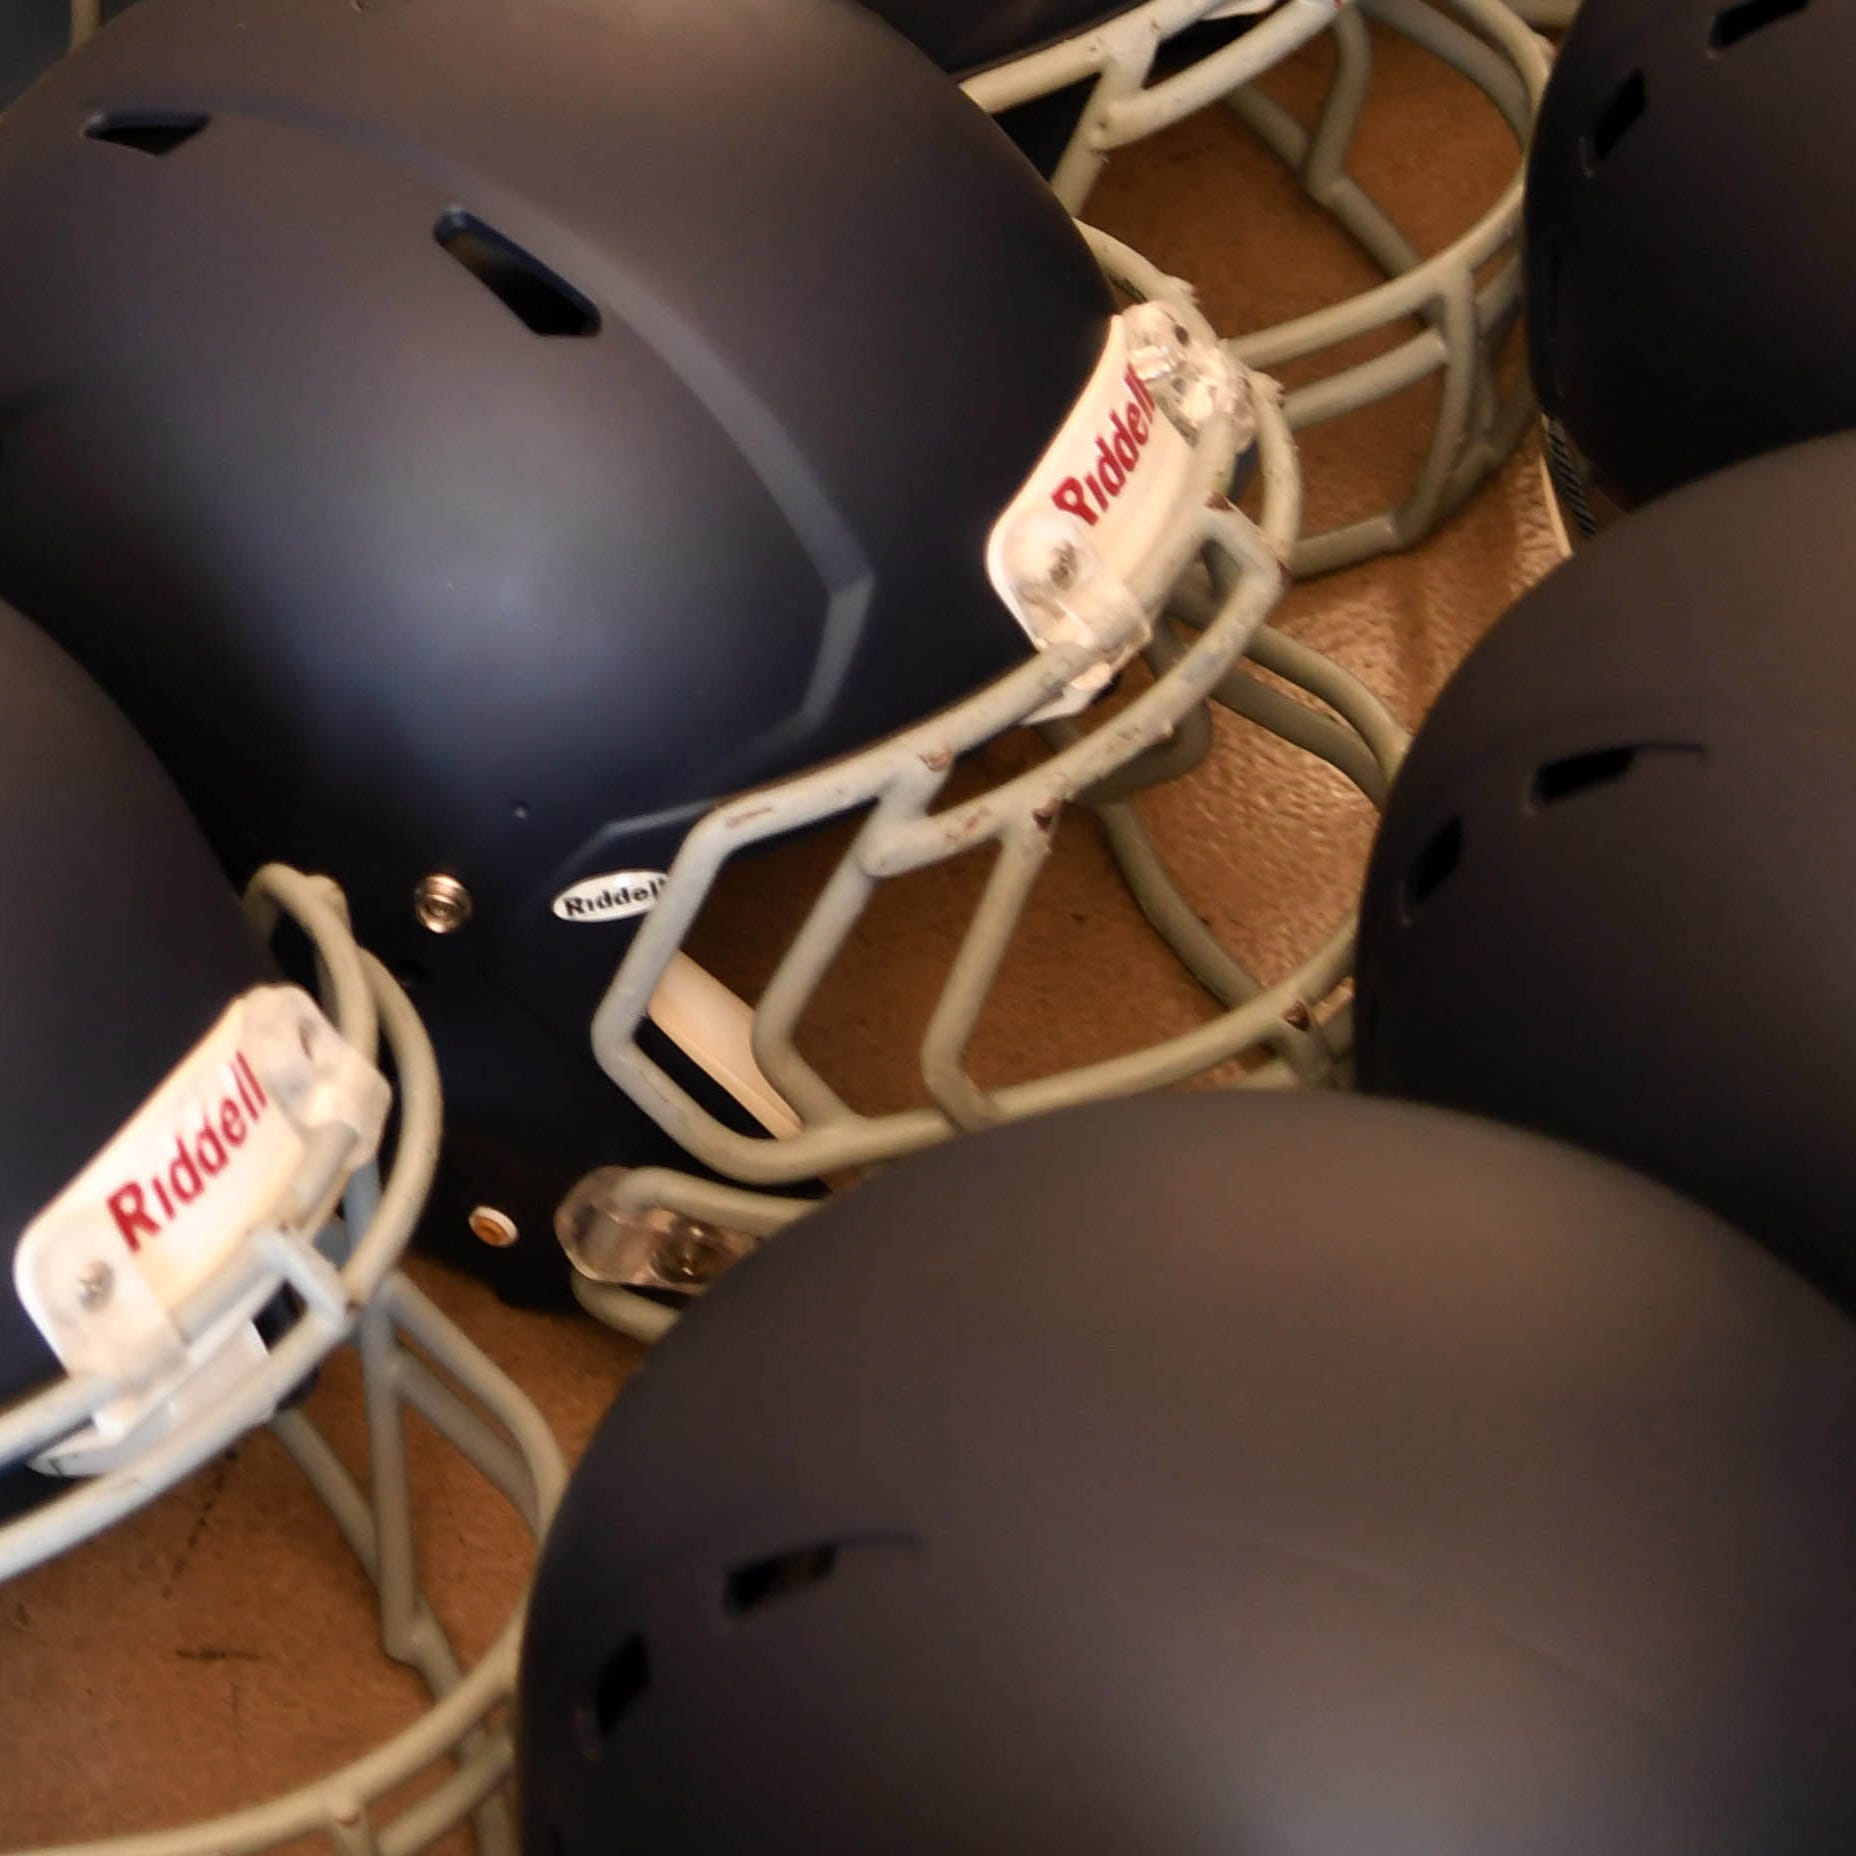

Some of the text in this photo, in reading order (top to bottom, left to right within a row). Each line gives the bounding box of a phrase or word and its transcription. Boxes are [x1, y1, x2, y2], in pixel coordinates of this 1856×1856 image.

[1051, 361, 1156, 527] Riddell
[562, 878, 665, 917] Riddel
[106, 1049, 269, 1253] Riddell
